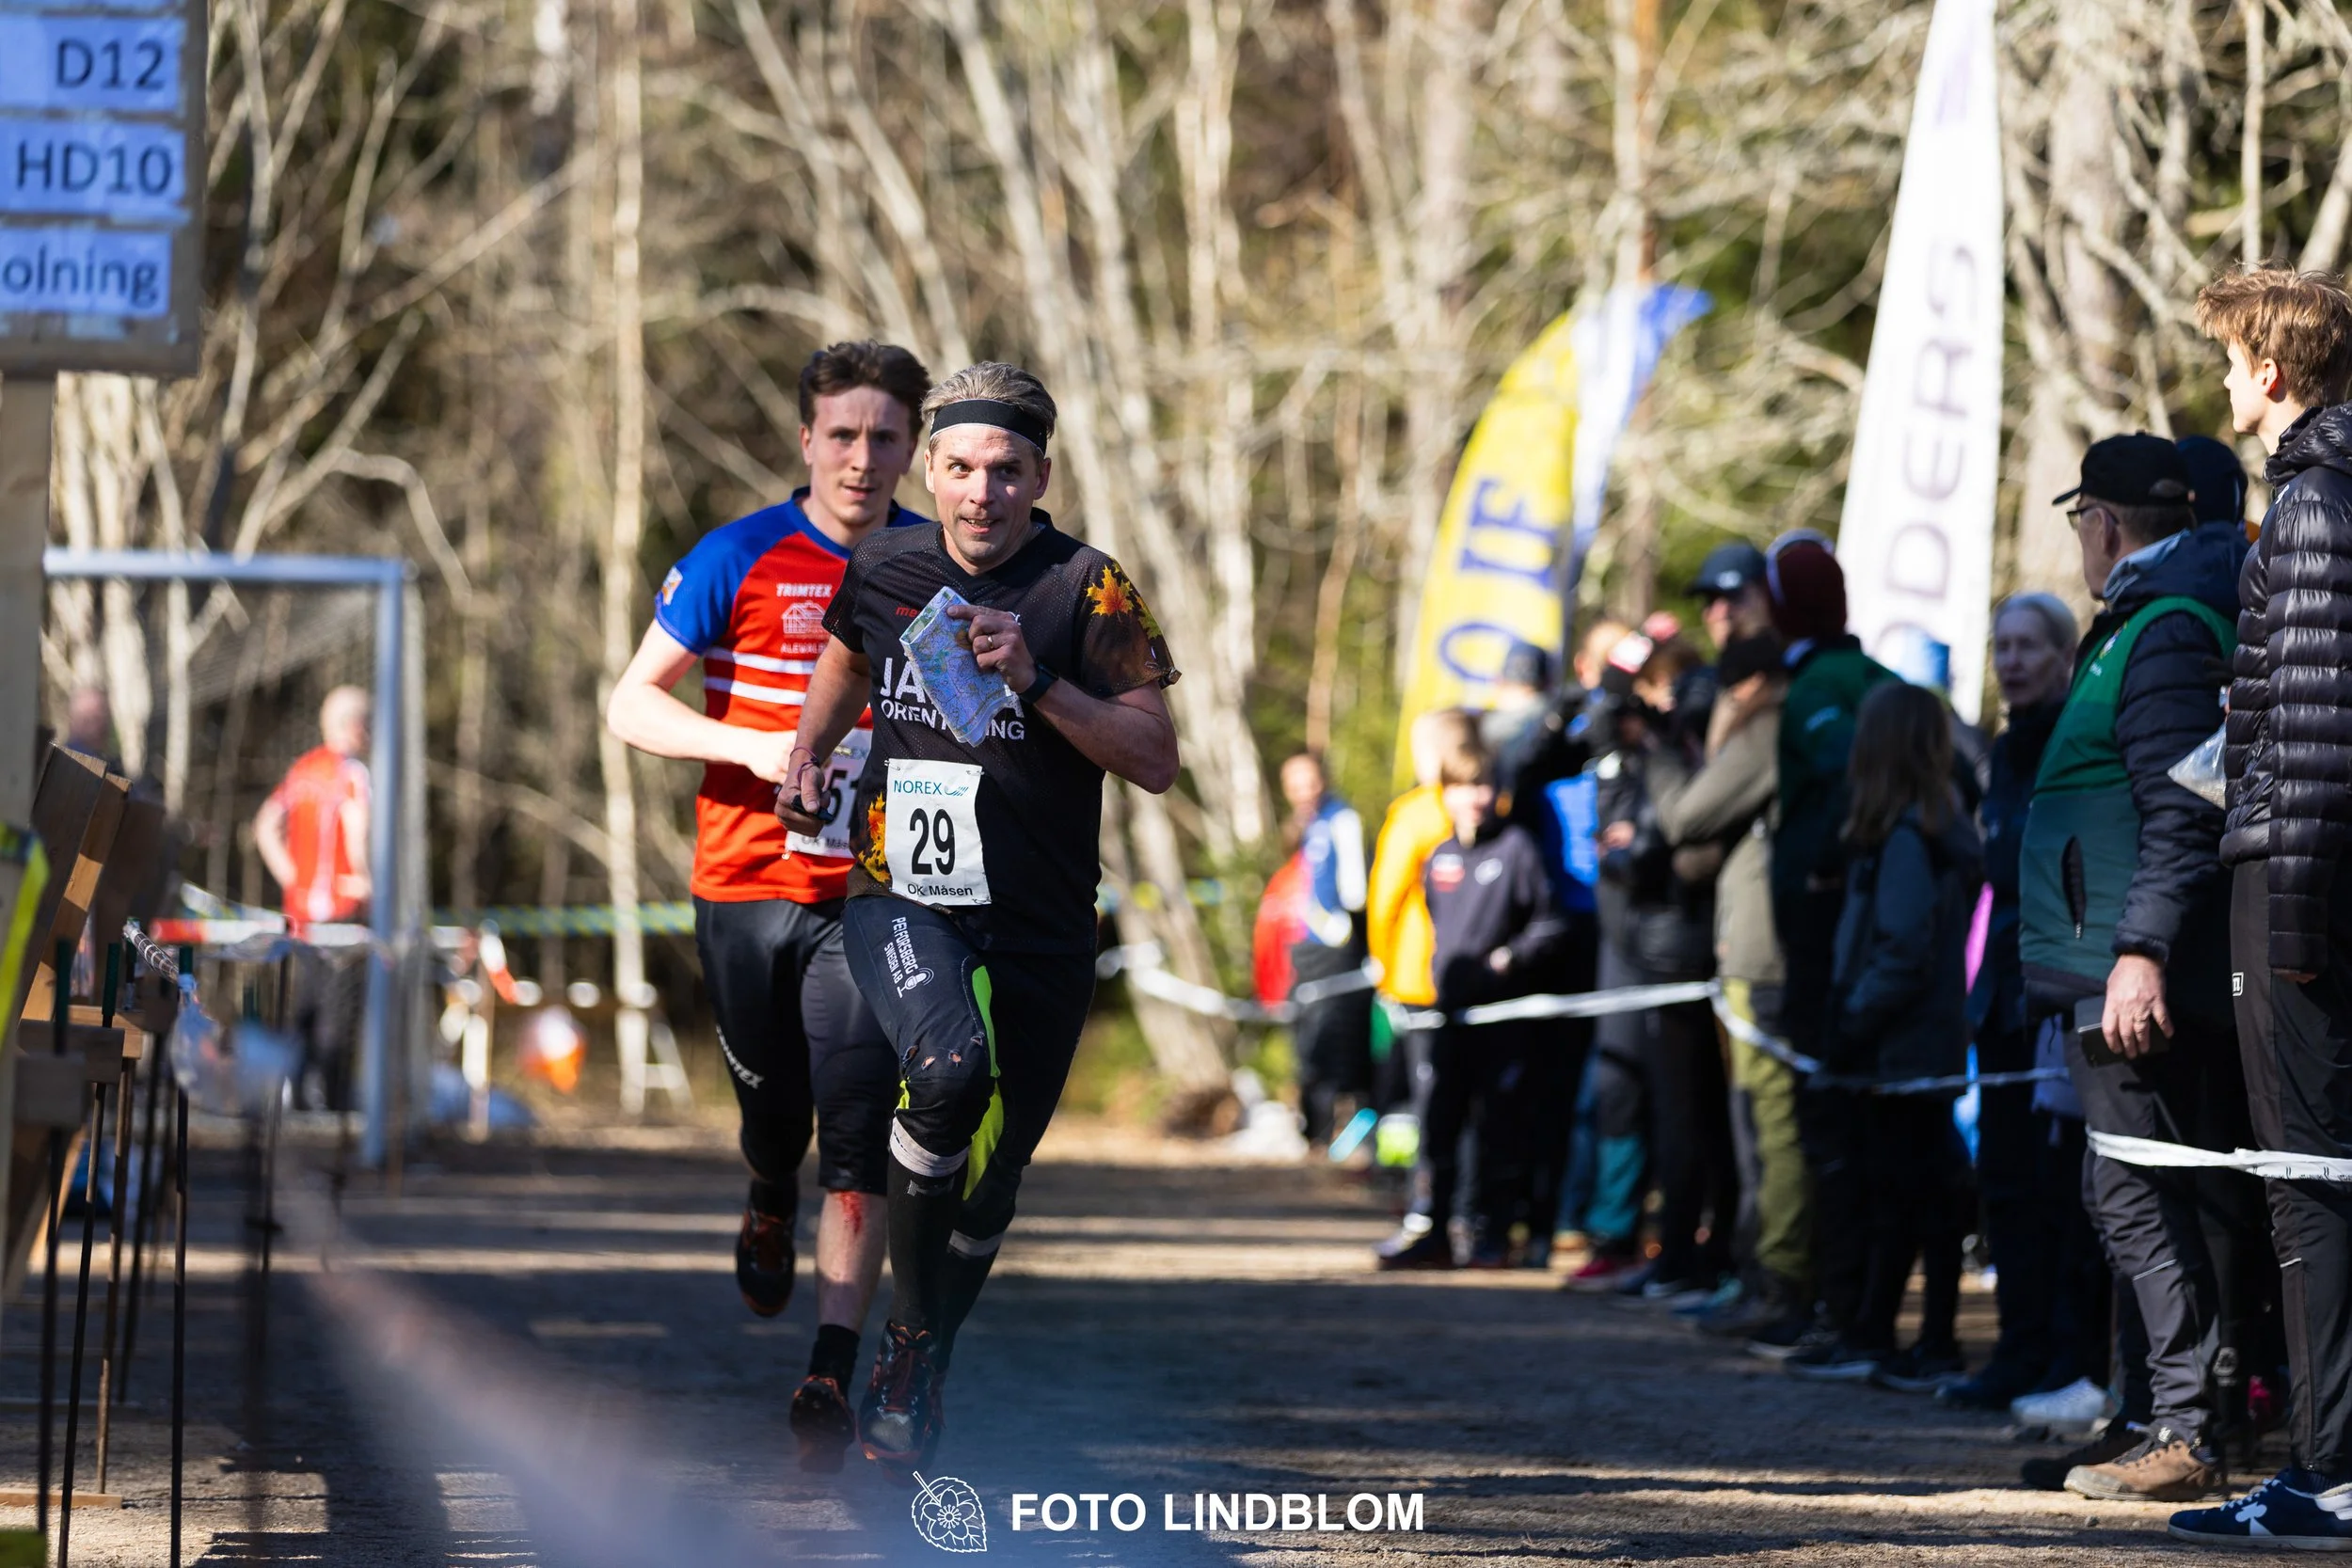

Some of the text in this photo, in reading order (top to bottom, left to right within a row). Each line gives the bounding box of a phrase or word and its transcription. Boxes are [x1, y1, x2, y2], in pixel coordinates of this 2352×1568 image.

[56, 39, 166, 90] D12
[17, 141, 172, 196] HD10
[776, 583, 832, 597] TRIMTEX
[894, 780, 943, 795] NOREX
[909, 808, 956, 876] 29
[907, 883, 974, 896] OK Måsen
[883, 942, 904, 985] SWEDEN AB
